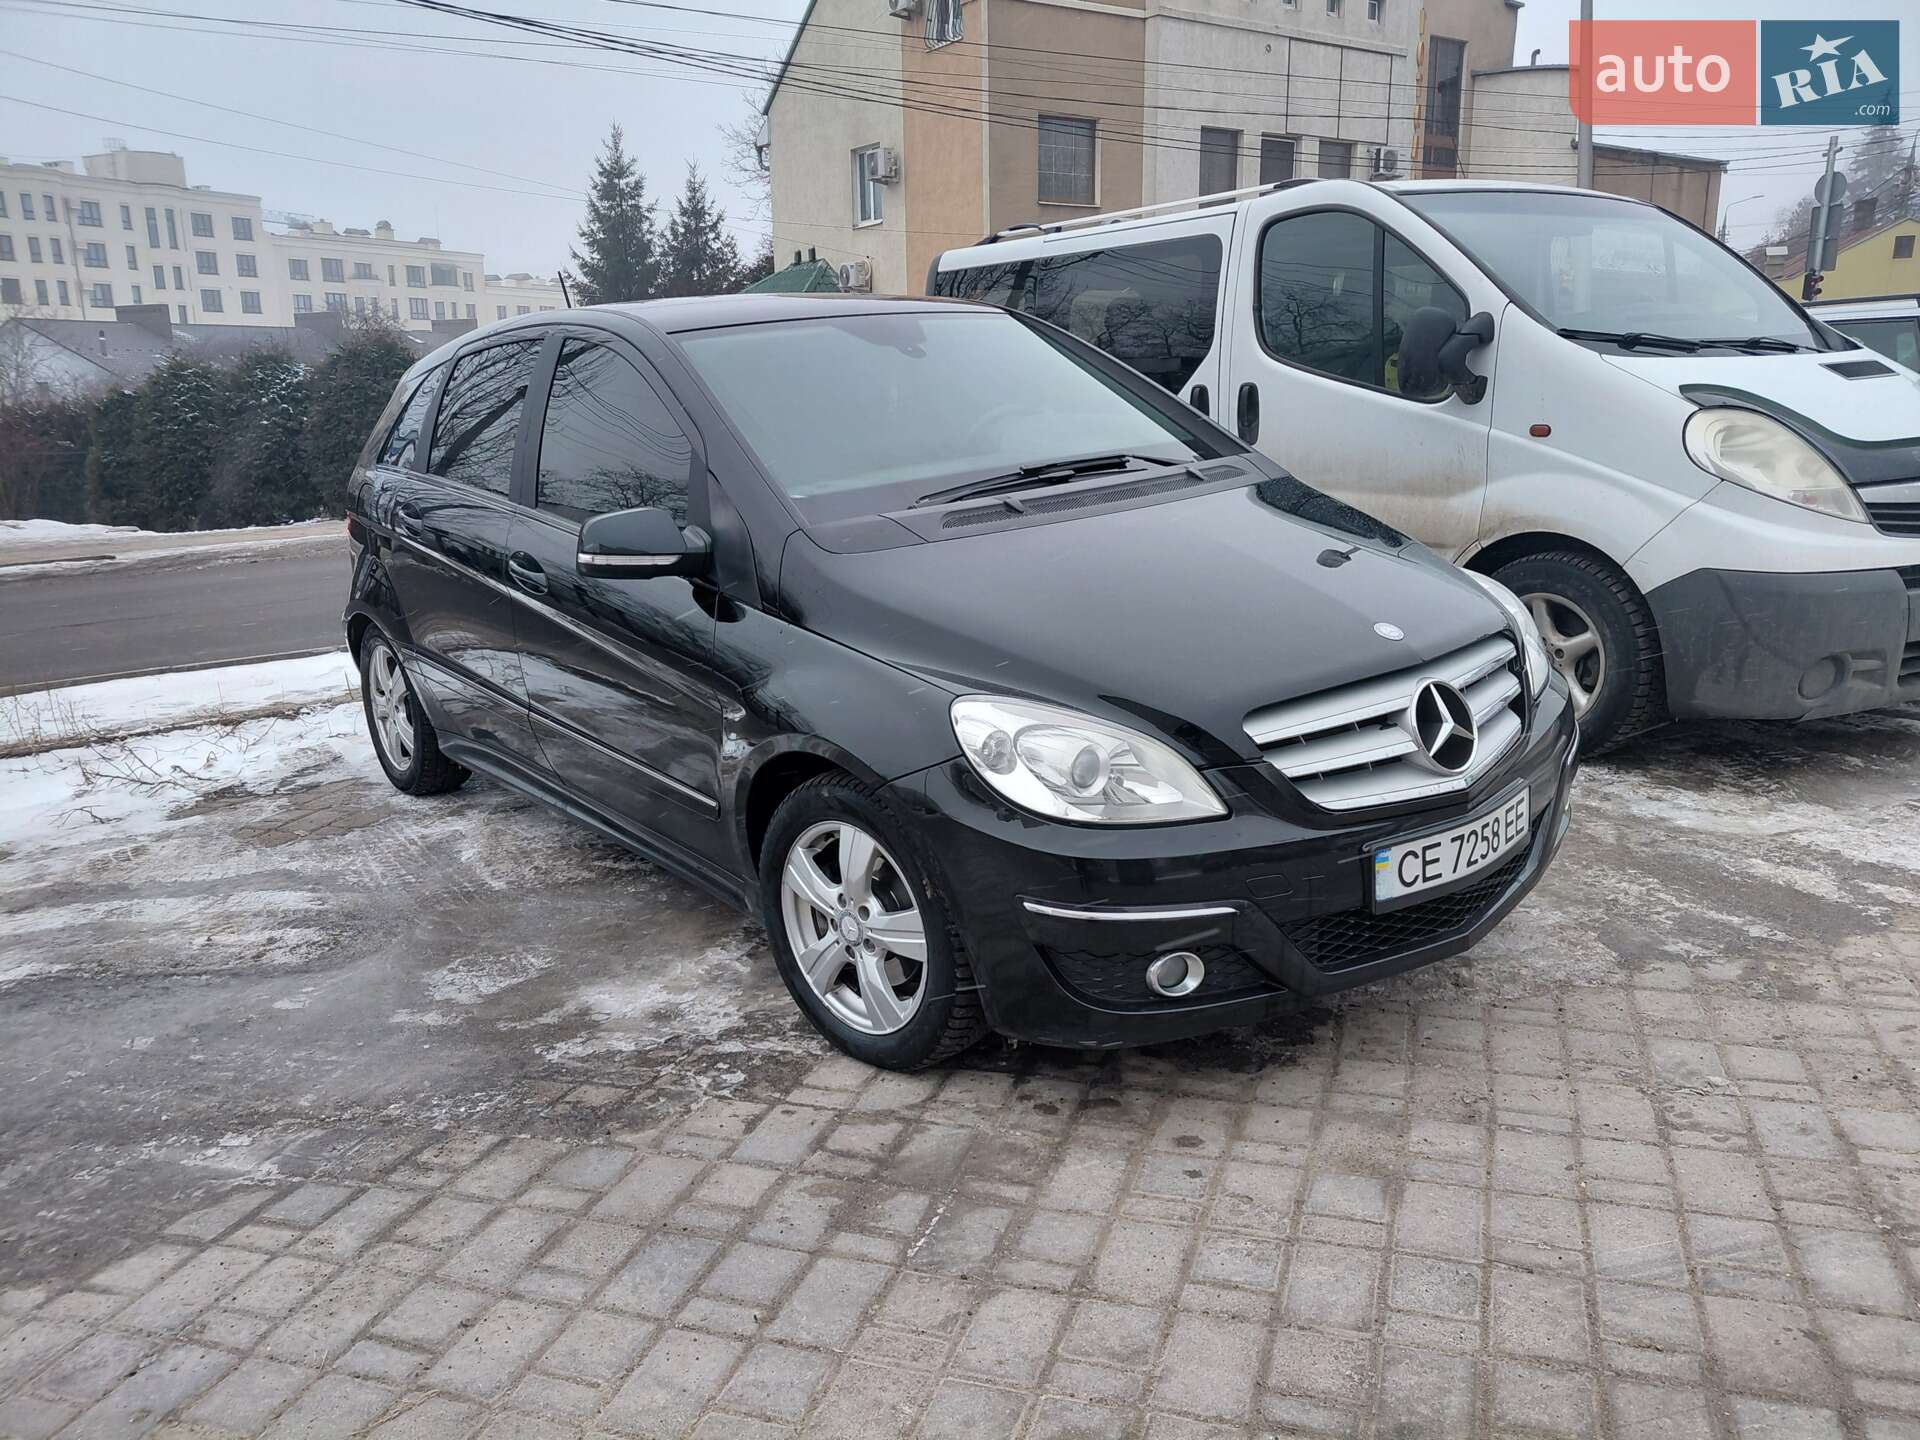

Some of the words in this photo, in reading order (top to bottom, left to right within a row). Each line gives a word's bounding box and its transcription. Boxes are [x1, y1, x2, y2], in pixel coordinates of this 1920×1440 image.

[1398, 842, 1442, 887] CE
[1450, 817, 1500, 874] 7258
[1504, 797, 1525, 844] EE
